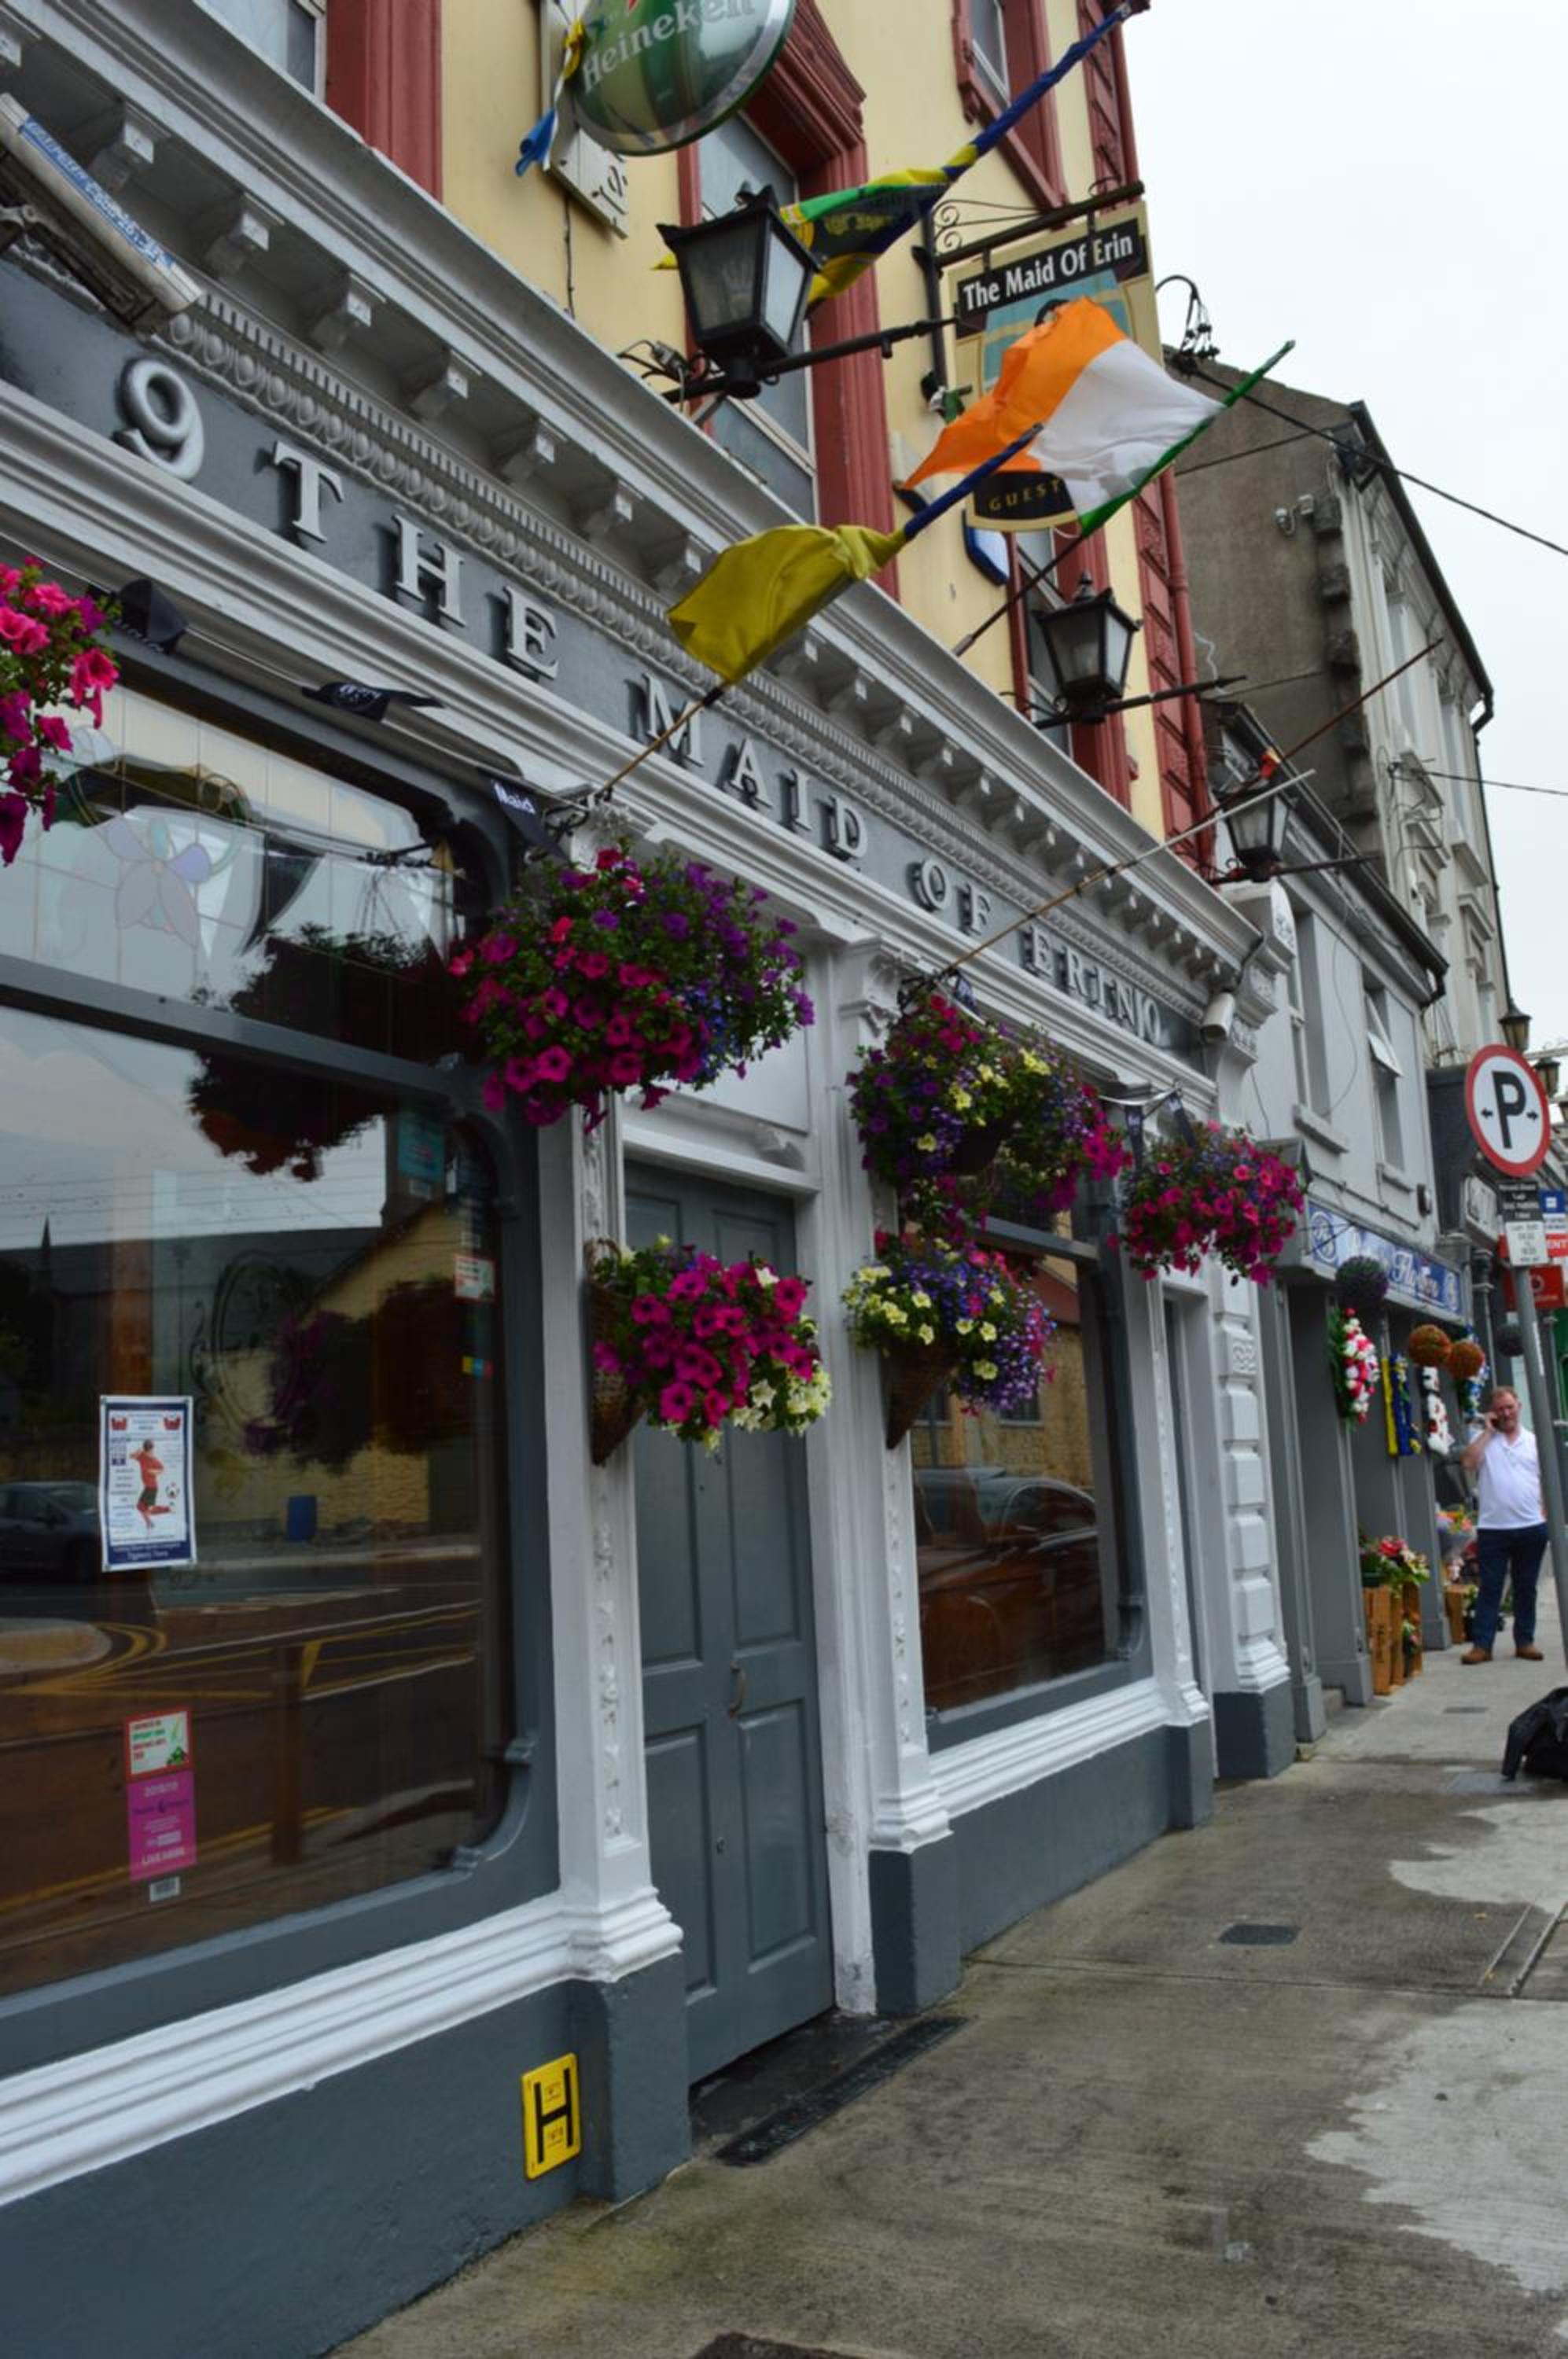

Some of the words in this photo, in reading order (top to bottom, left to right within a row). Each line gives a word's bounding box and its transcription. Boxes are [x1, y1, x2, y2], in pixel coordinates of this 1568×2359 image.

[580, 0, 756, 94] Heineken
[963, 281, 1000, 311] The
[1005, 253, 1055, 298] Maid
[1061, 243, 1088, 276] Of
[1092, 232, 1133, 266] Erin
[988, 478, 1061, 511] GUEST
[122, 359, 204, 481] 9
[273, 440, 558, 680] THE
[642, 673, 869, 859] MAID
[919, 858, 992, 937] OF
[1491, 1070, 1526, 1150] P
[533, 2067, 574, 2164] H
